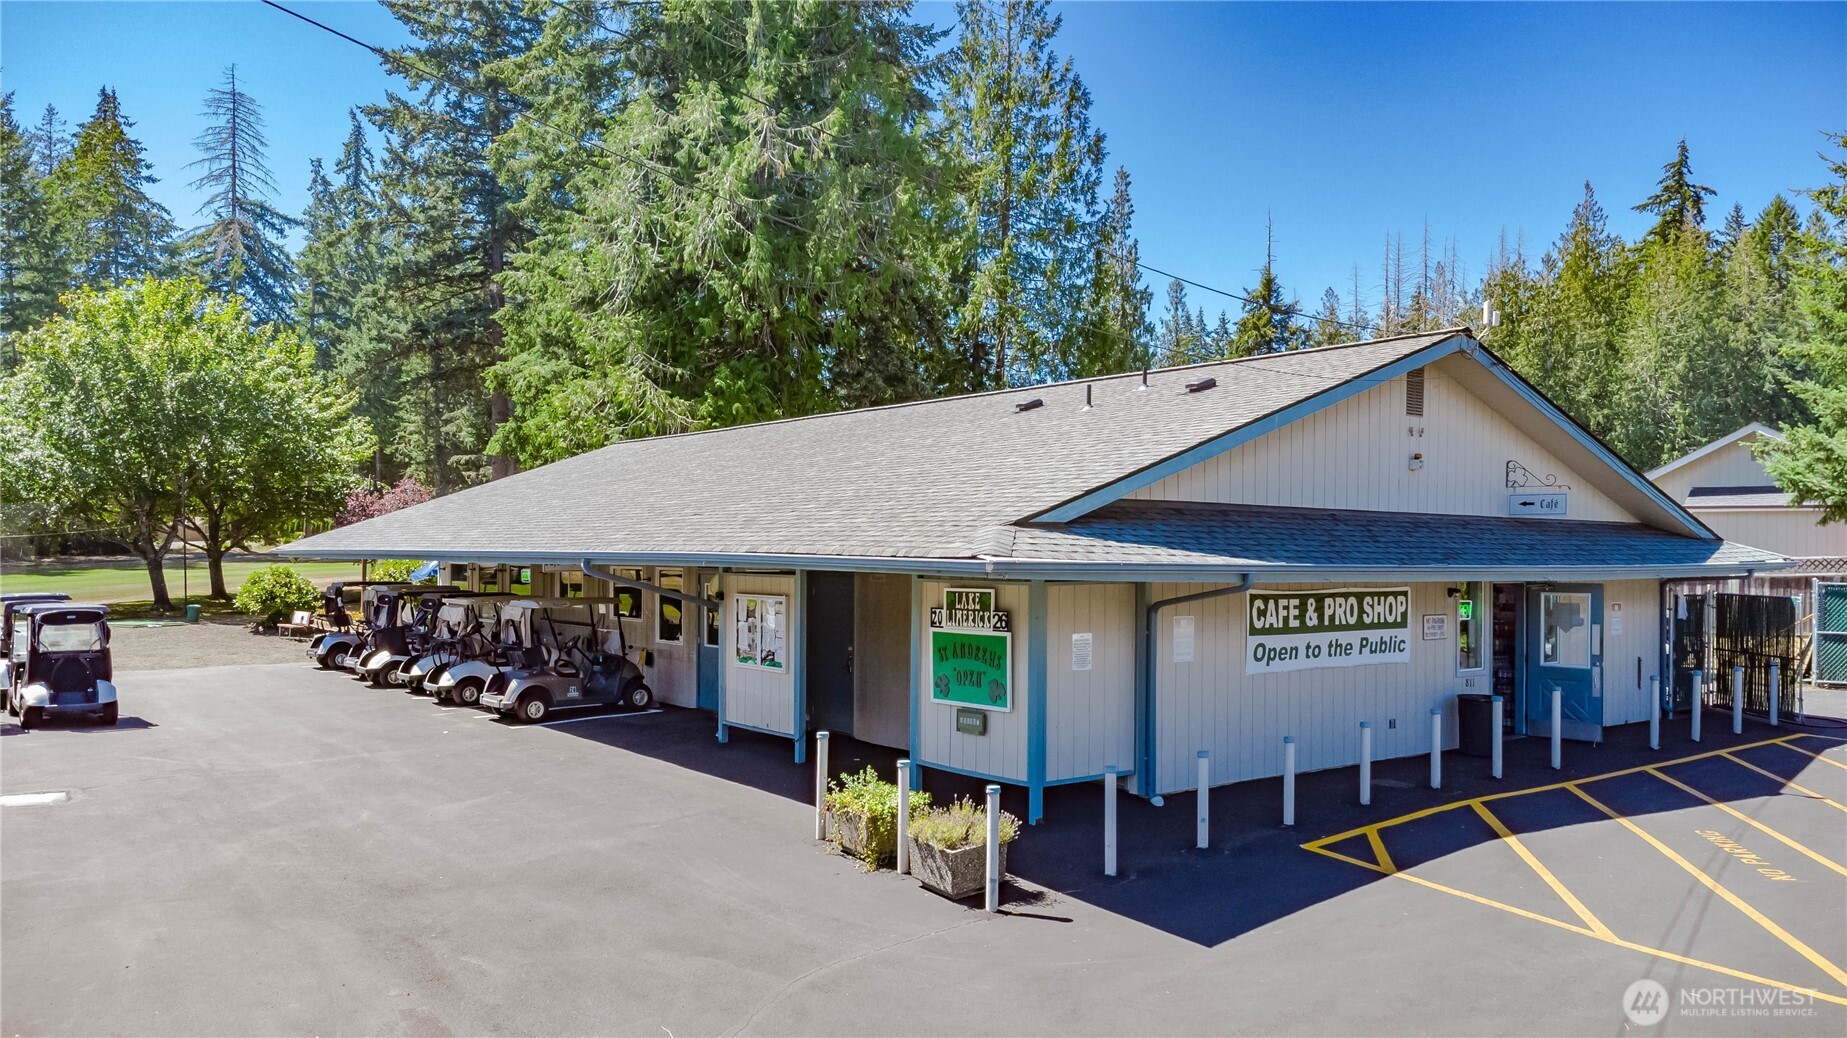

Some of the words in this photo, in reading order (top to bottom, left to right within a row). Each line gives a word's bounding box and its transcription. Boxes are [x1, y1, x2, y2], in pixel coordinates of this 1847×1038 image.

[1540, 498, 1559, 510] Café
[955, 592, 981, 610] LAKE
[1251, 598, 1300, 629] CAFE
[1305, 597, 1319, 627] &
[1324, 596, 1358, 626] PRO
[1362, 595, 1407, 624] SHOP
[946, 609, 991, 629] LIMERICK
[952, 642, 1002, 670] ANDREWS
[1253, 642, 1299, 667] Open
[1305, 640, 1322, 659] to
[1327, 638, 1354, 658] the
[1359, 635, 1407, 655] Public
